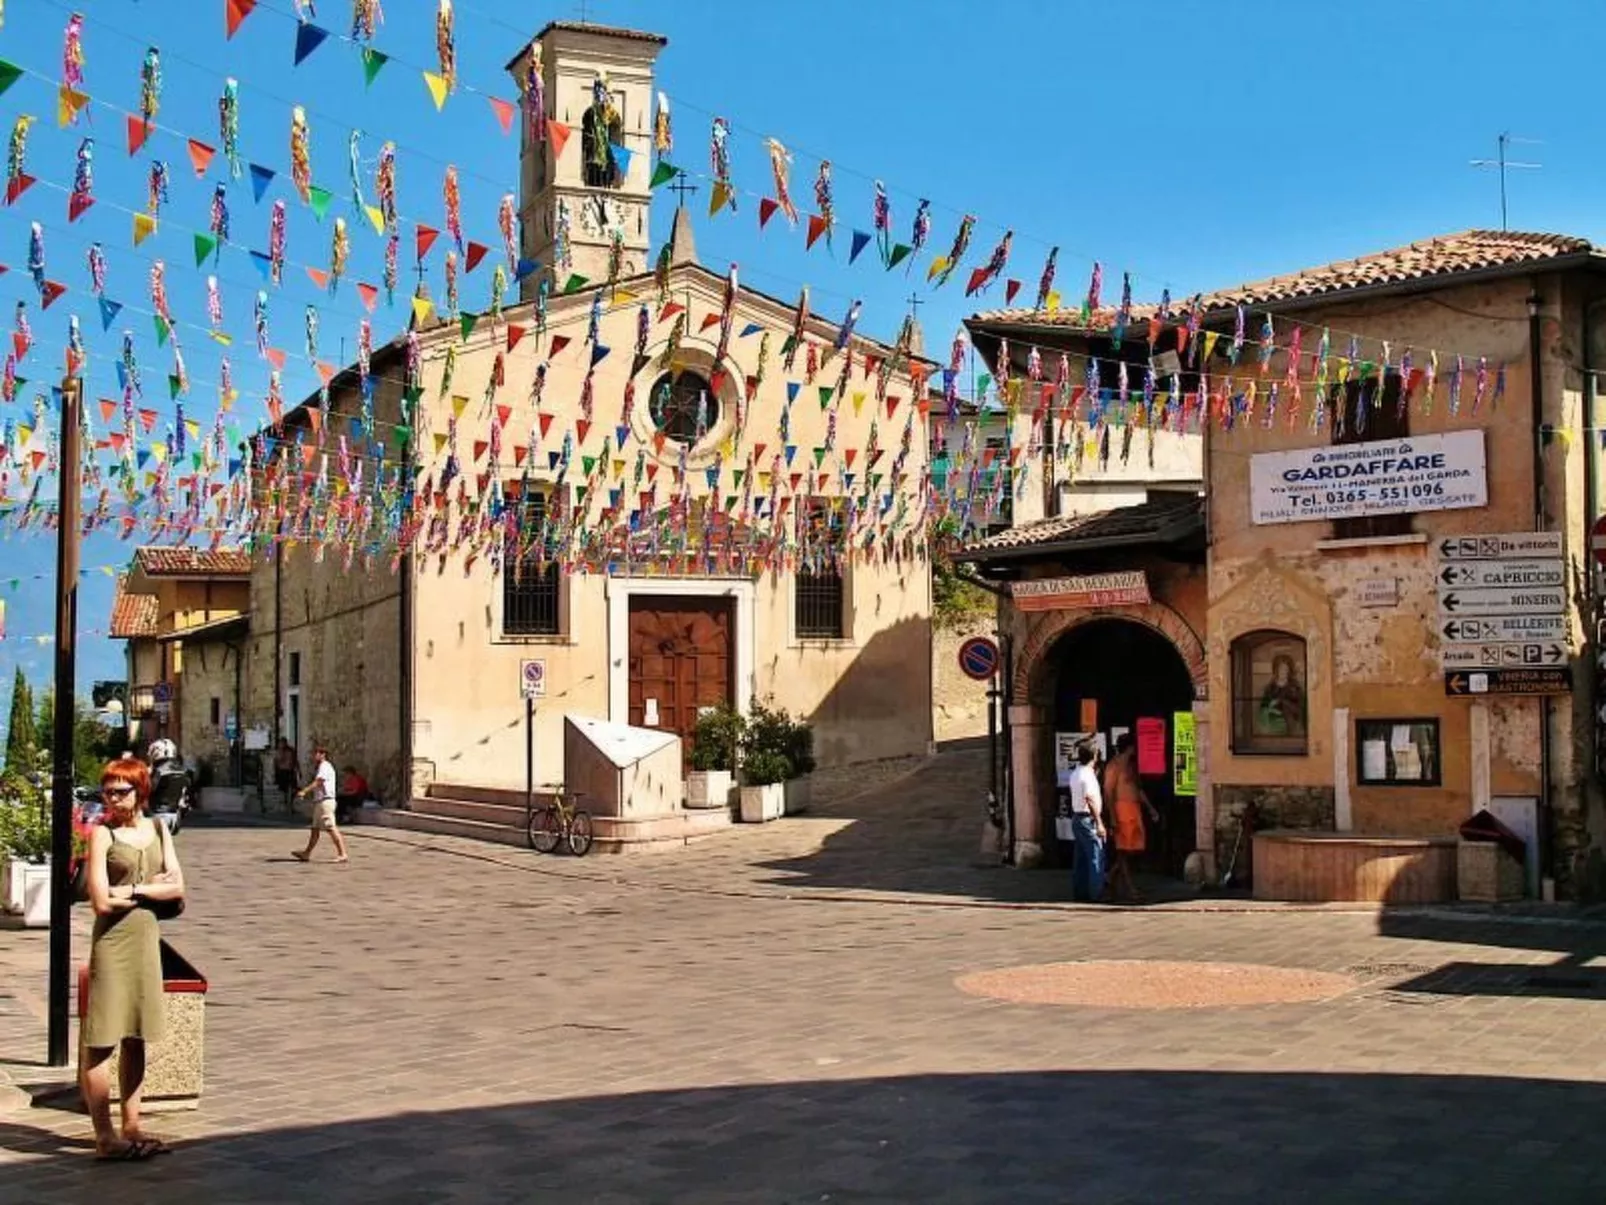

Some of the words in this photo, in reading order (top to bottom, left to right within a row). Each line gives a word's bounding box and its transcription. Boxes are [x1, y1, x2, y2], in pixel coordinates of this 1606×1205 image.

[1283, 453, 1446, 481] GARDAFFARE
[1408, 473, 1425, 482] del
[1427, 468, 1471, 480] GARDA
[1288, 494, 1322, 507] Tel.
[1326, 483, 1444, 505] 0365-551096
[1483, 571, 1561, 584] CAPRICCIO
[1511, 593, 1562, 606] MINERVA
